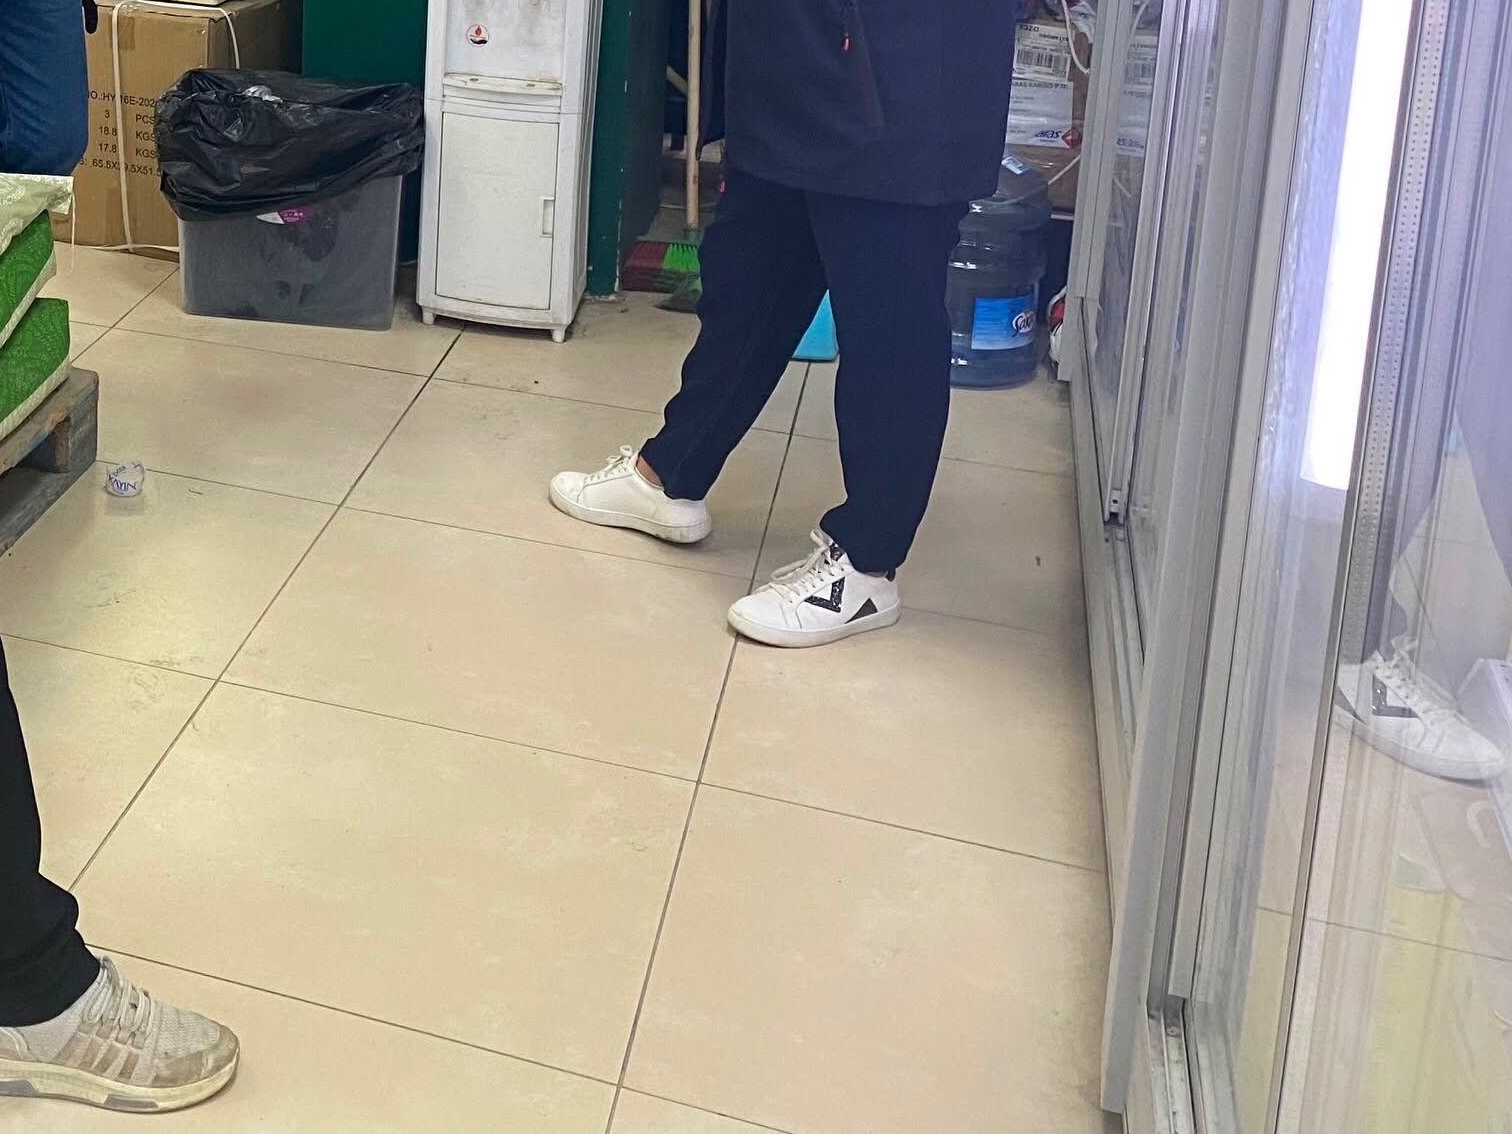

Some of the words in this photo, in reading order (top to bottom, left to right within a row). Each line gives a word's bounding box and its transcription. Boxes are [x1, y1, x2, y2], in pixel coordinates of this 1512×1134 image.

[104, 109, 111, 119] 3
[135, 114, 156, 125] PCS
[98, 125, 118, 137] 18.8
[135, 131, 157, 143] KGS
[98, 142, 118, 154] 17.8
[135, 147, 157, 160] KGS
